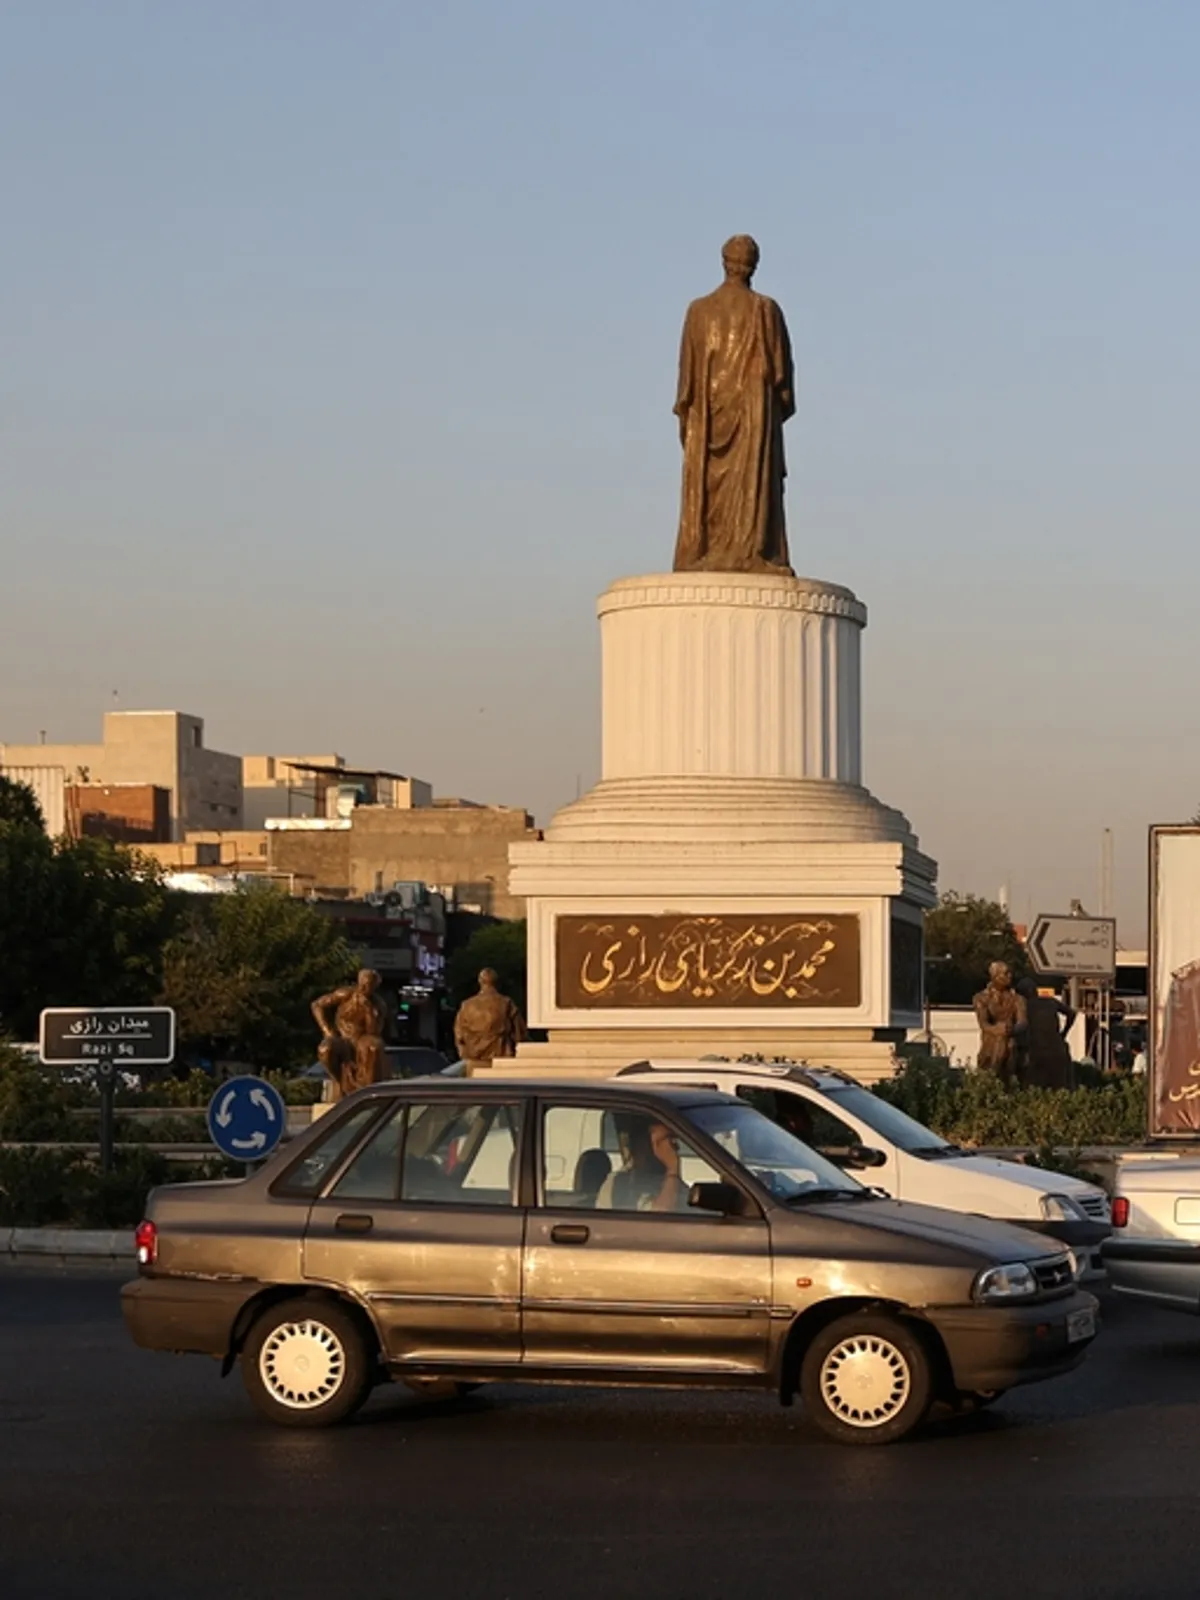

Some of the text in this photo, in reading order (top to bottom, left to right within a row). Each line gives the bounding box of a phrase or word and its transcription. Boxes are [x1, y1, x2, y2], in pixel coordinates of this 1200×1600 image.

[580, 925, 656, 993] رازی
[750, 949, 798, 998] بن
[789, 940, 835, 980] محمد
[70, 1016, 149, 1034] میدان رازی
[82, 1043, 112, 1055] Razi
